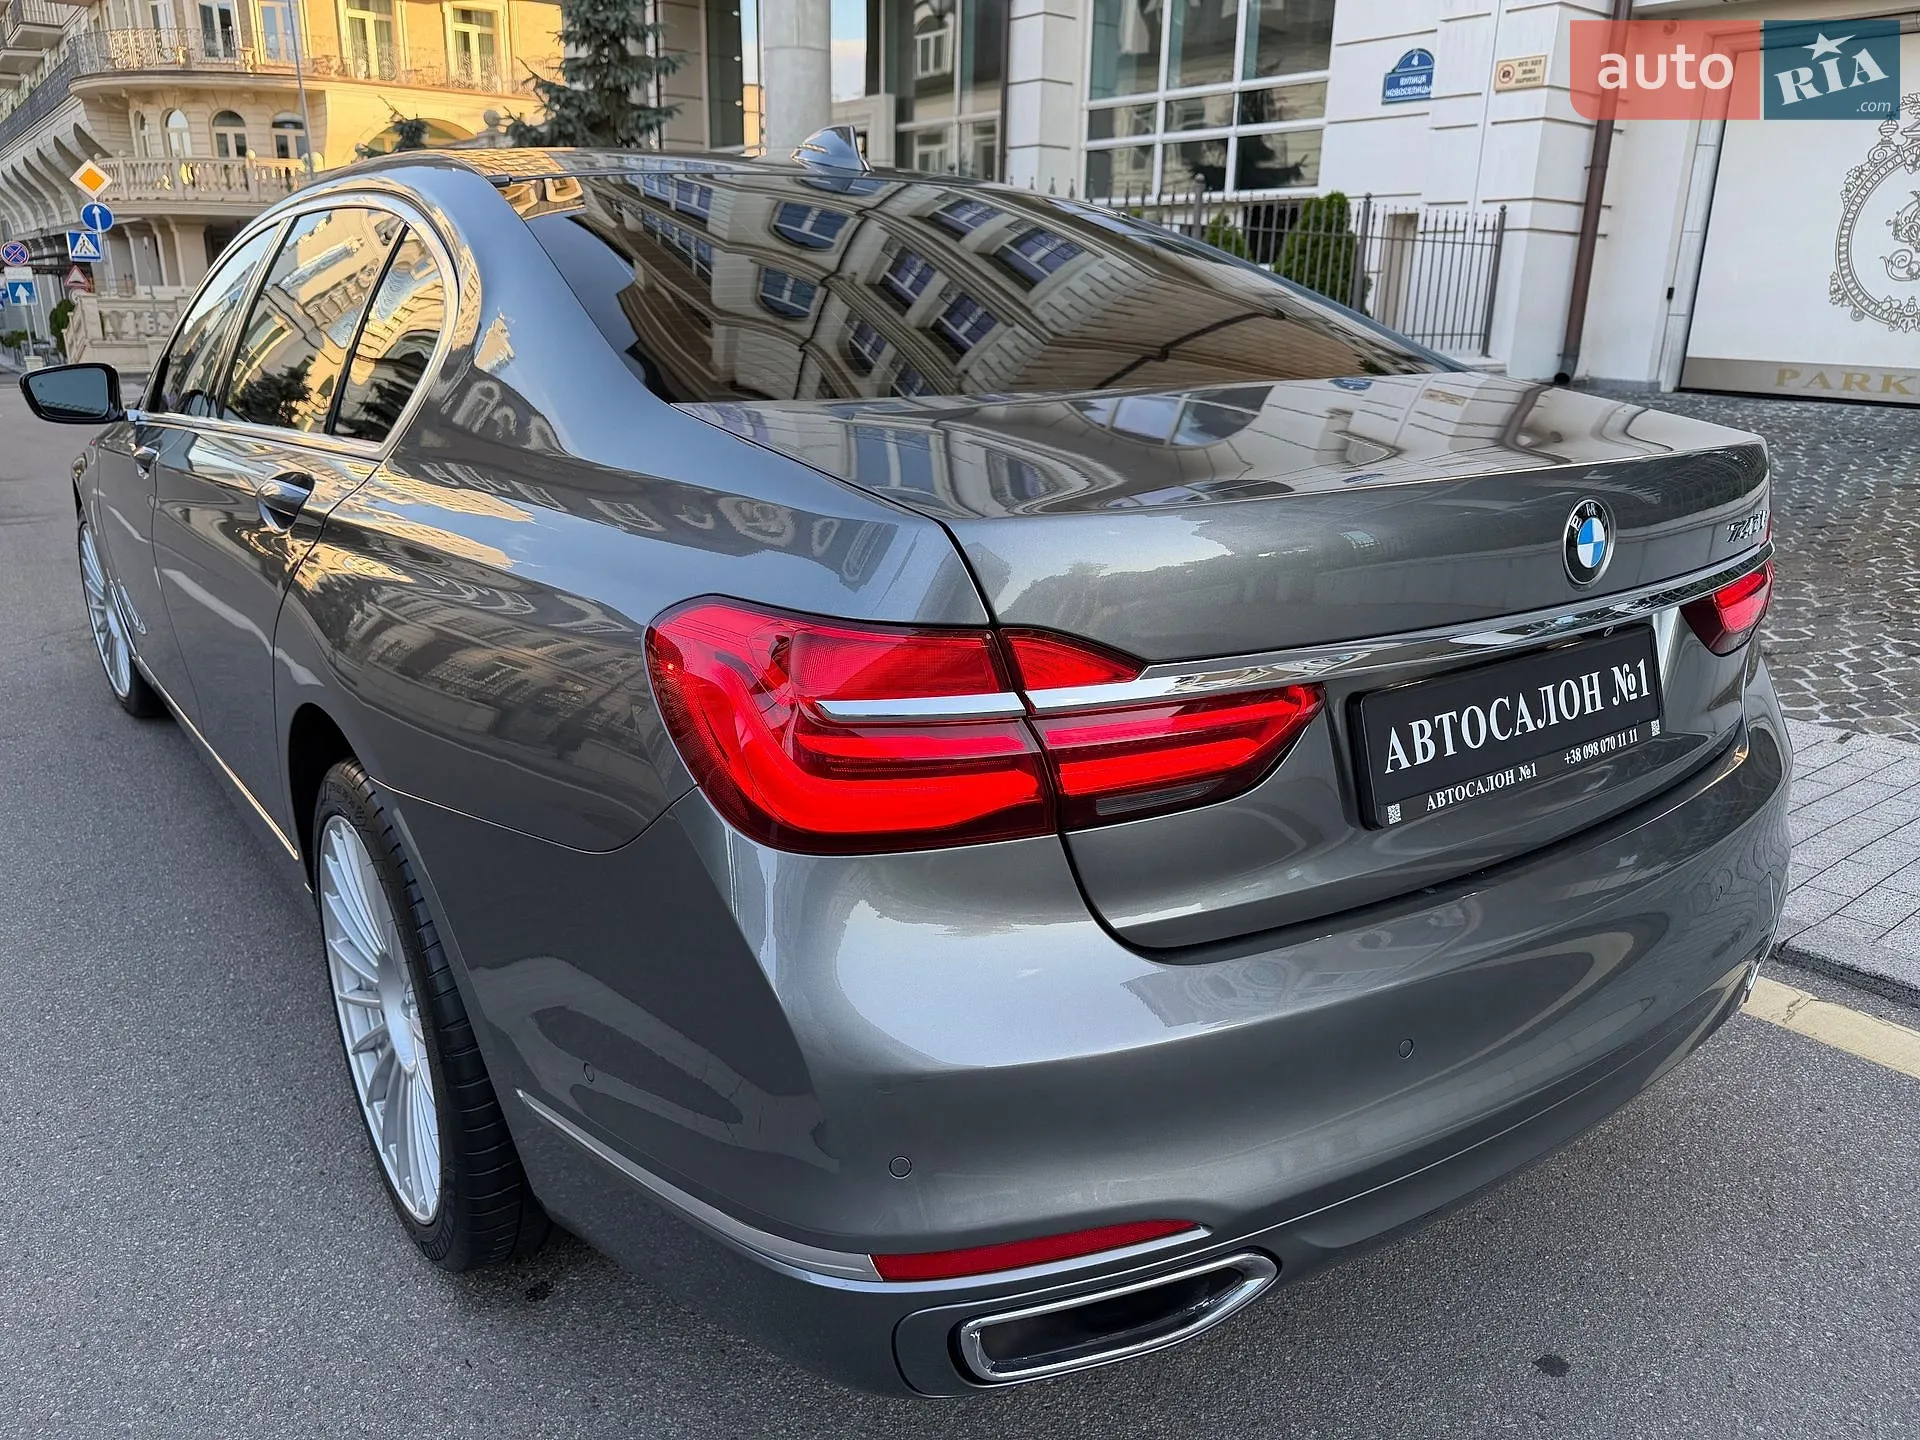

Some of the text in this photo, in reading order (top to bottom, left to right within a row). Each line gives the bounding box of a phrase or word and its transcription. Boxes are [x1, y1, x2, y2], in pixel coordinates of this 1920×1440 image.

[1384, 658, 1651, 774] АВТОСАЛОН №1
[1564, 728, 1638, 765] +38 098 070 11 11
[1426, 762, 1537, 811] АВТОСАЛОН №1
